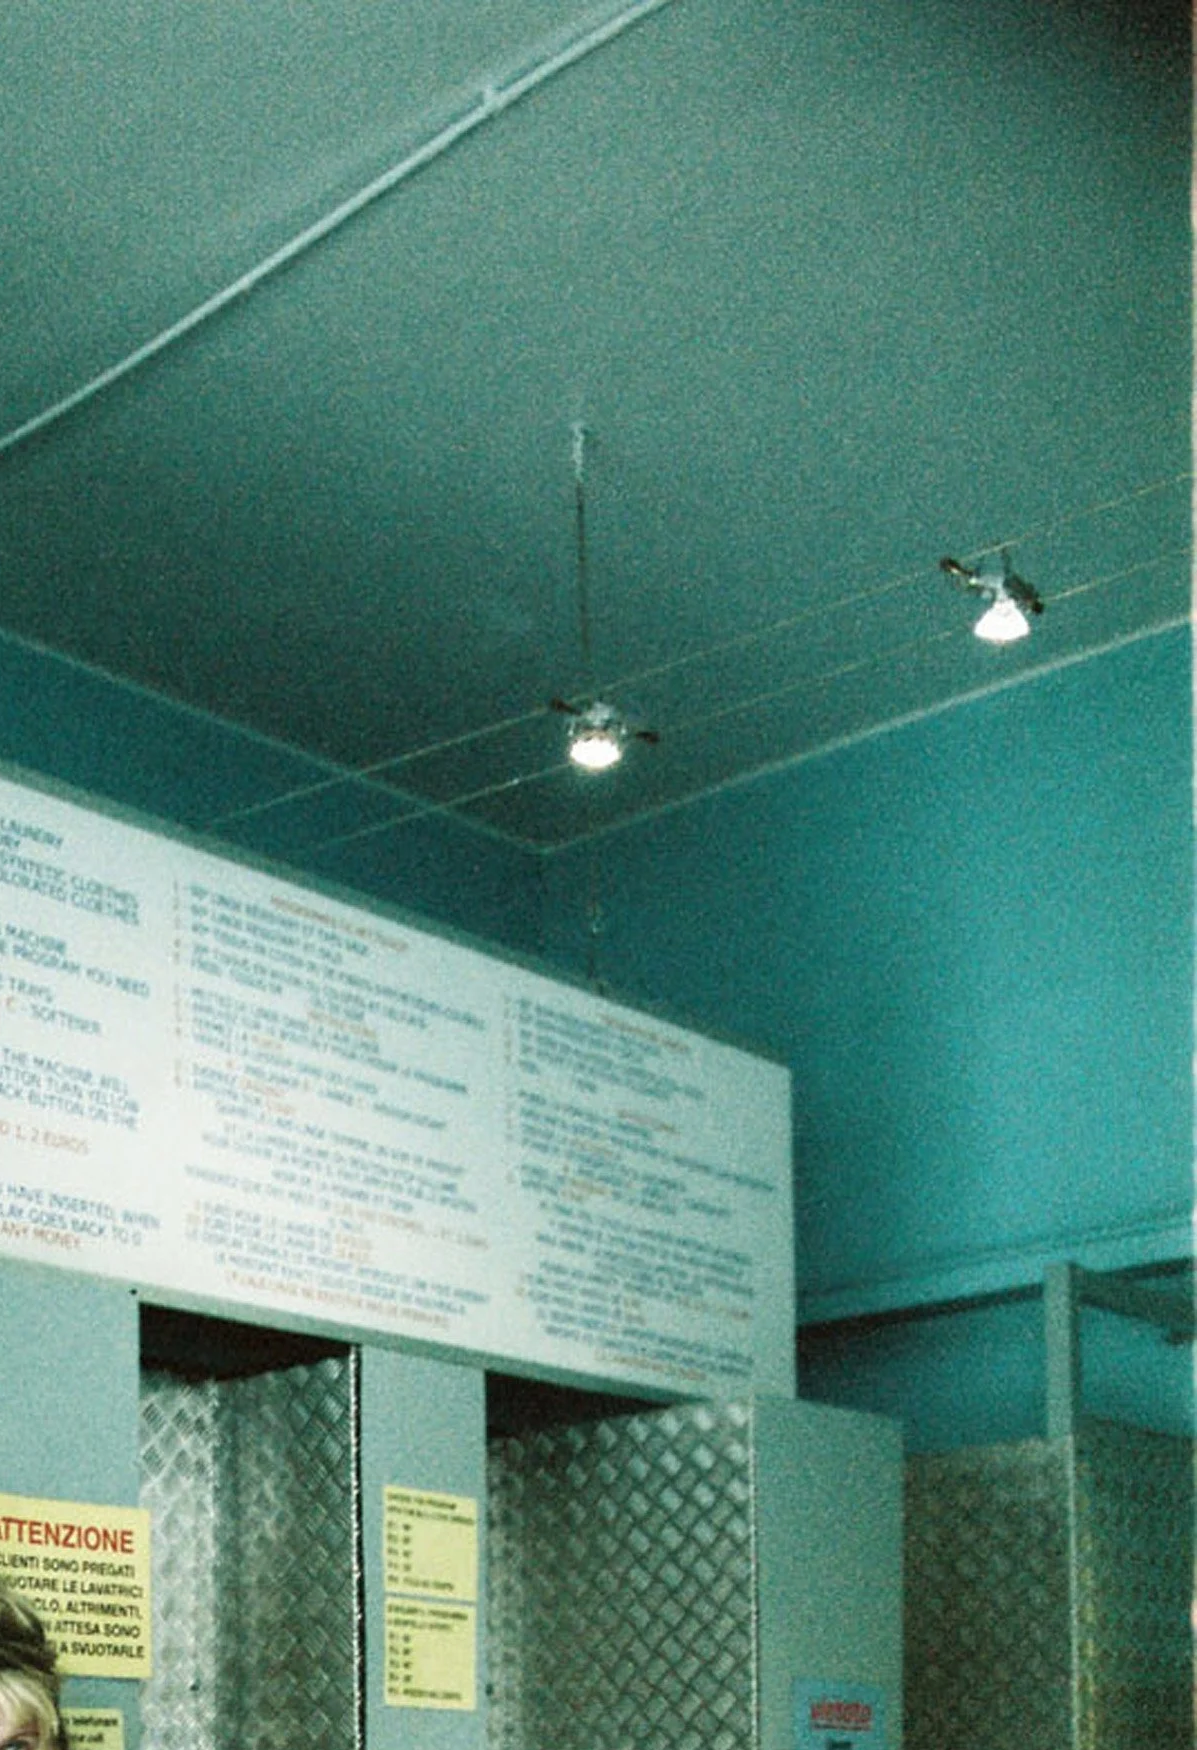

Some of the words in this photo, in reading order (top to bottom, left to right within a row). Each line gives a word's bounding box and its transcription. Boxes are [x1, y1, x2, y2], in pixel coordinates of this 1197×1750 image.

[42, 1558, 79, 1573] SONO
[83, 1561, 135, 1578] PREGATI
[62, 1580, 78, 1594] LE
[80, 1581, 144, 1599] LAVATRICI
[54, 1620, 100, 1635] ATTESA
[103, 1623, 141, 1639] SONO
[59, 1641, 68, 1653] A
[71, 1642, 145, 1659] SVUOTARLE
